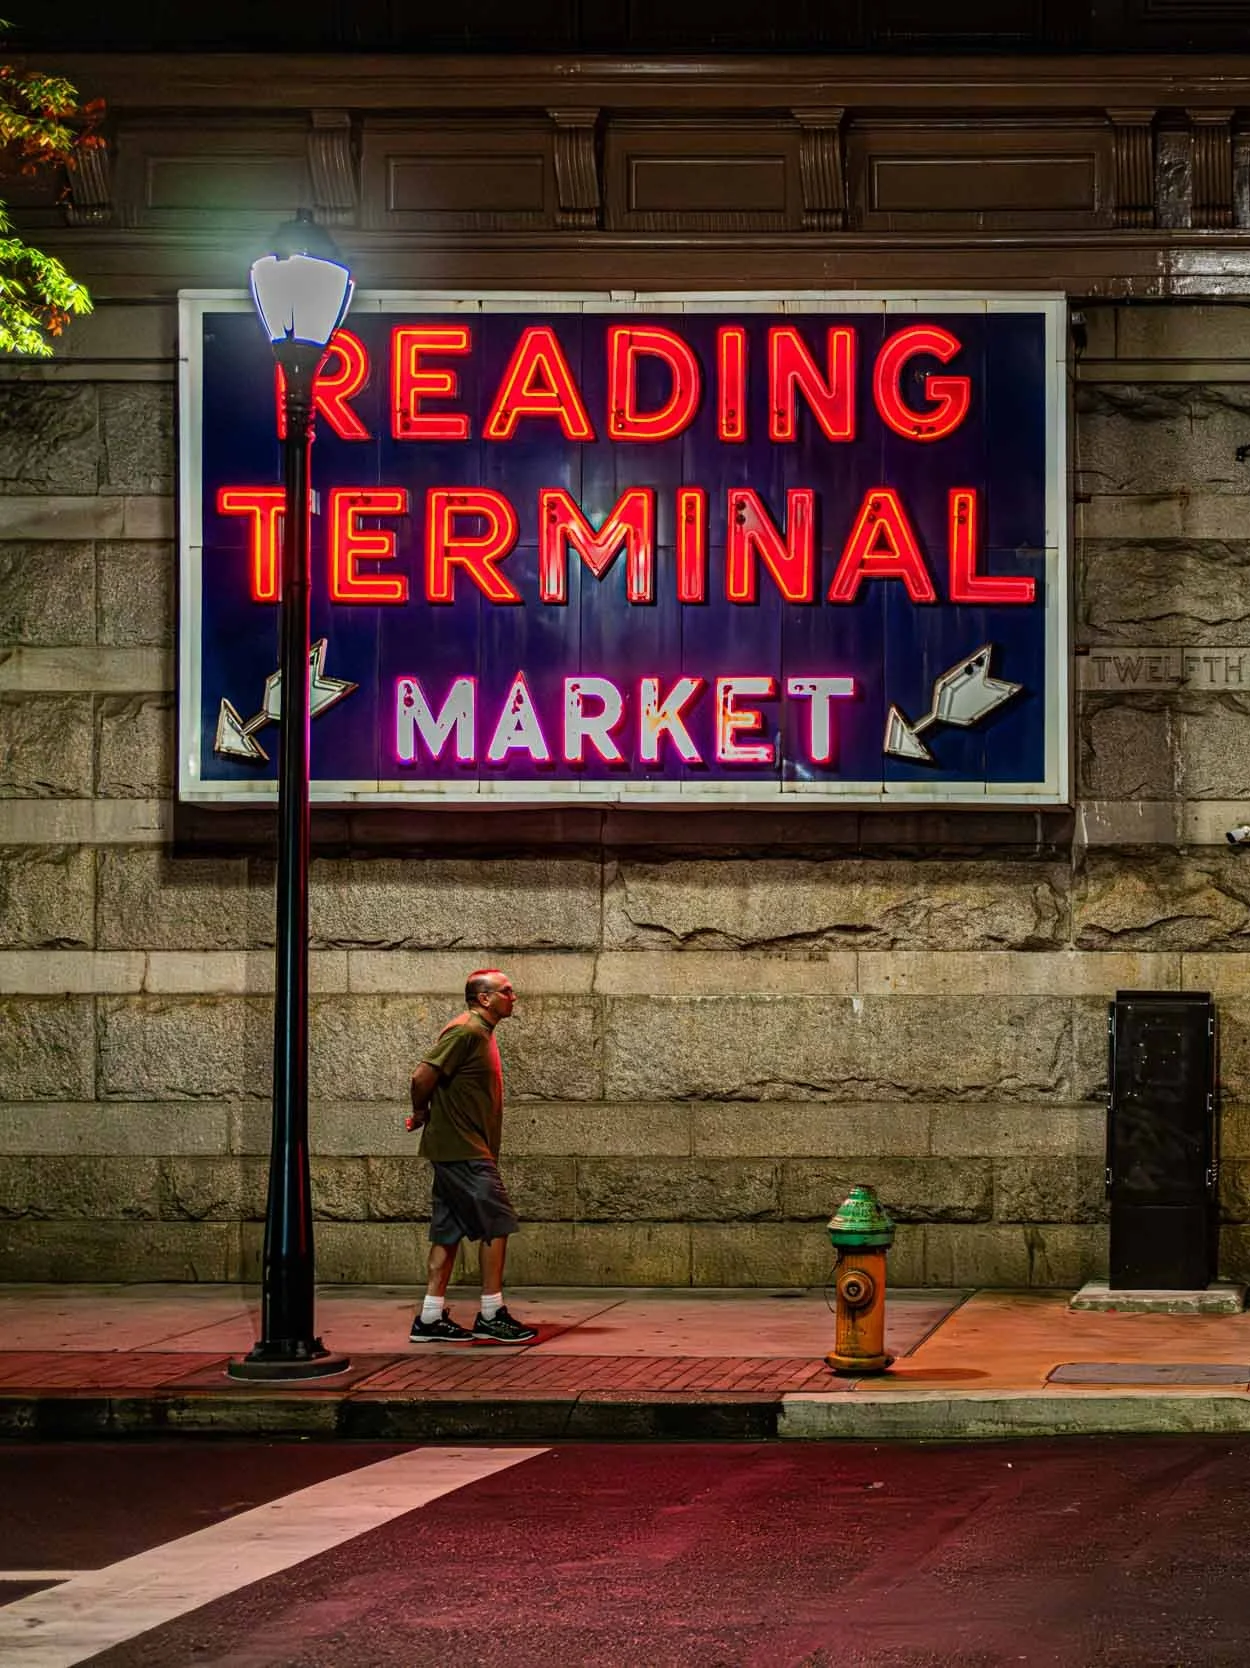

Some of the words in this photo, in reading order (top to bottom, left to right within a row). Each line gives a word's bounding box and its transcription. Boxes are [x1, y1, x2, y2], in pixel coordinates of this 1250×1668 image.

[276, 323, 972, 442] READING
[217, 488, 1037, 605] TERMINAL
[395, 671, 855, 766] MARKET
[1092, 656, 1244, 684] TWELFTH
